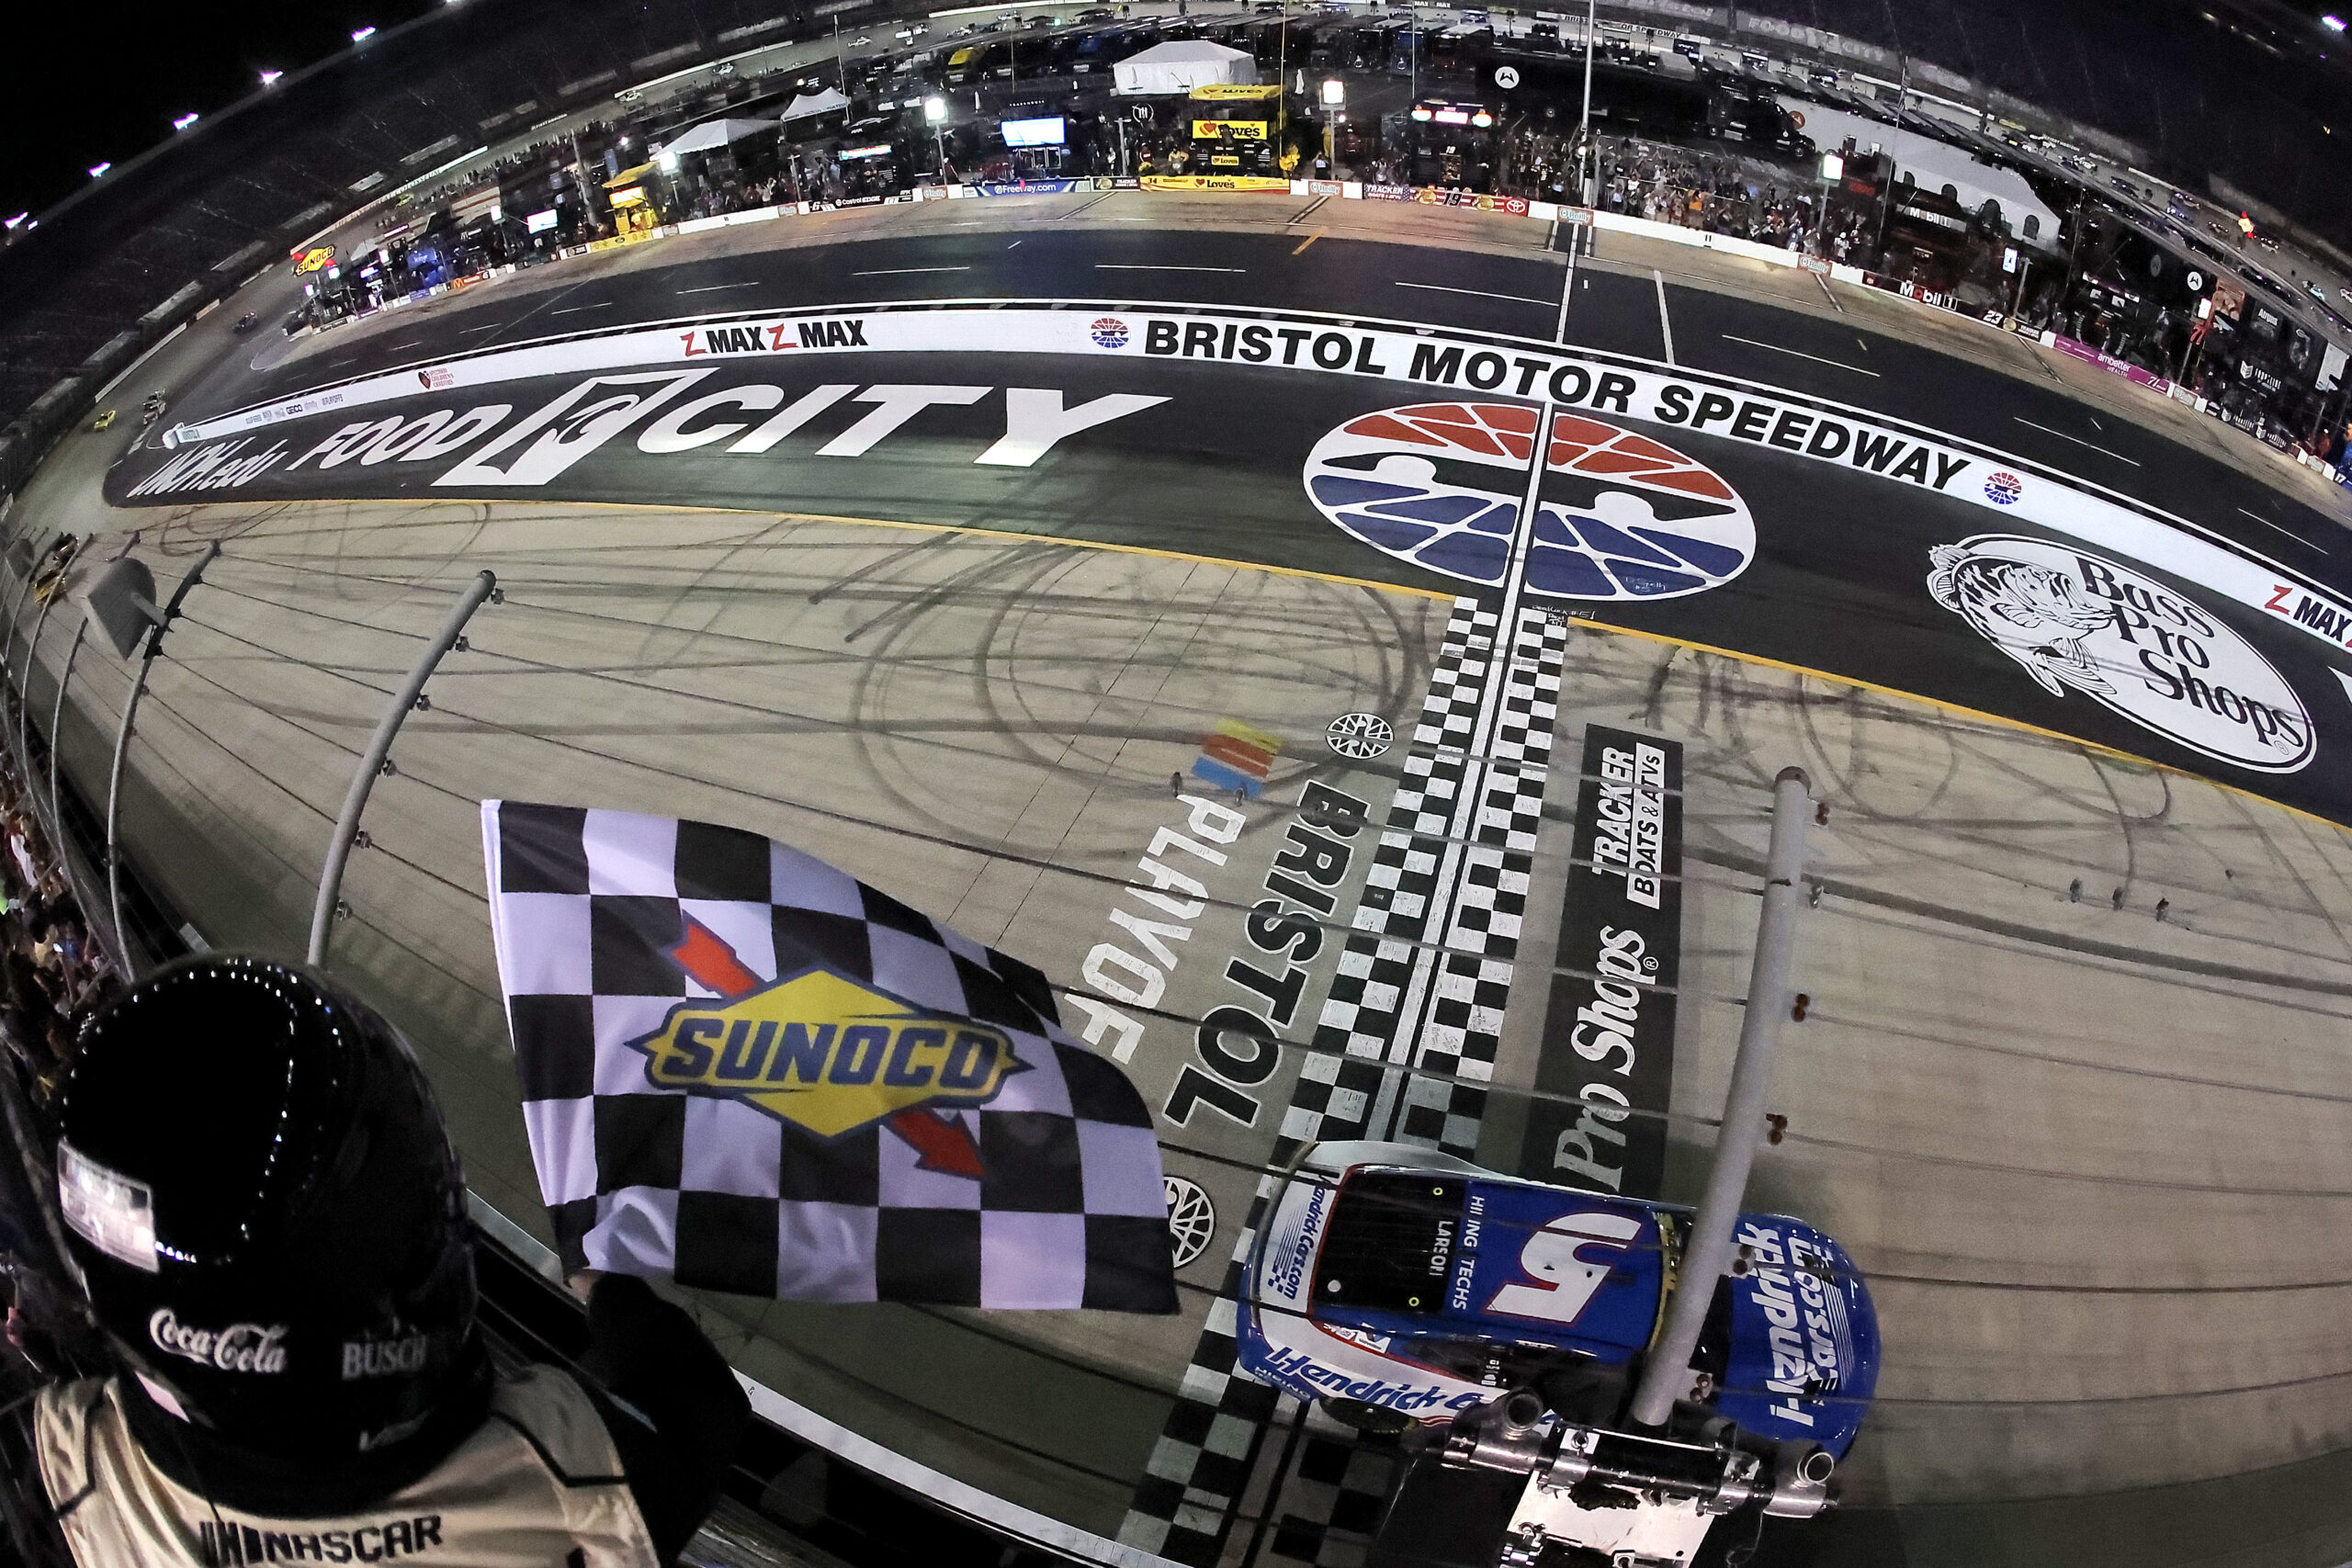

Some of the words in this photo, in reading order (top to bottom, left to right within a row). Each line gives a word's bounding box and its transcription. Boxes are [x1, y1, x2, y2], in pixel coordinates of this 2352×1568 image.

[1635, 24, 1681, 39] SPEDWAY
[1365, 185, 1404, 195] TRACKER
[1443, 192, 1463, 207] 19
[297, 246, 333, 275] SUNOCO
[1899, 283, 1942, 306] Mobil
[1983, 310, 2004, 325] 23
[2097, 353, 2132, 373] ambetter
[285, 403, 514, 470] FOOD
[637, 383, 1175, 468] CITY
[1145, 320, 1386, 376] BRISTOL
[1408, 343, 1636, 414] MOTOR
[1654, 383, 1971, 492] SPEEDWAY
[2335, 472, 2346, 484] 17
[2075, 555, 2215, 638] Bass
[2109, 601, 2211, 669] Pro
[2138, 649, 2304, 748] Shops
[1591, 746, 1634, 879] TRACKER
[1634, 819, 1659, 897] BOATS
[1066, 793, 1247, 1066] PLAYOF
[1161, 779, 1373, 1130] BRISTOL
[1570, 924, 1657, 1077] Shops
[662, 1017, 1000, 1091] SUNOCO
[1553, 1082, 1631, 1192] Pro
[1429, 1220, 1453, 1276] LARSON
[1486, 1211, 1643, 1324] 5
[1452, 1256, 1476, 1311] TECHS
[149, 1306, 288, 1374] Coca-Cola
[342, 1333, 427, 1380] BUSCH
[263, 1515, 443, 1564] NASCAR
